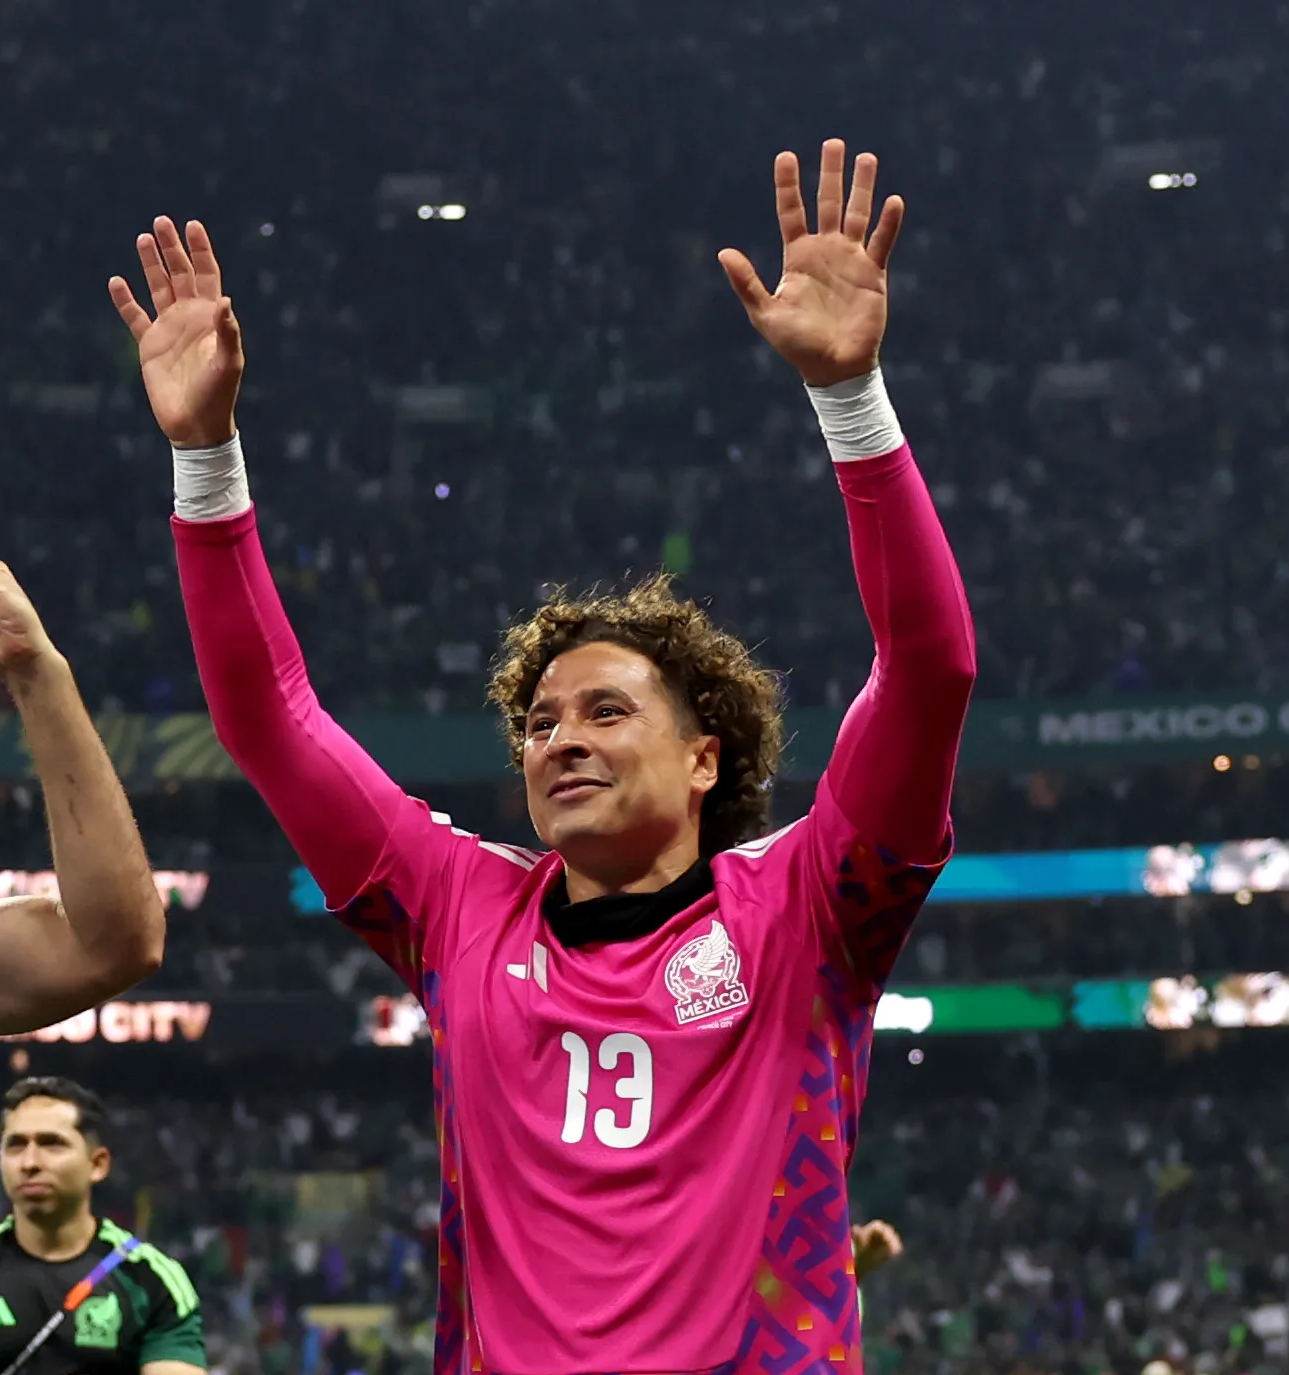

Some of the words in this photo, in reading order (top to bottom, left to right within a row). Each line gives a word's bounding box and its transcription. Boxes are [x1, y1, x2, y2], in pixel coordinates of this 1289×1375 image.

[1037, 702, 1269, 744] MEXICO
[679, 989, 744, 1020] MÉXICO
[561, 1031, 653, 1148] 13
